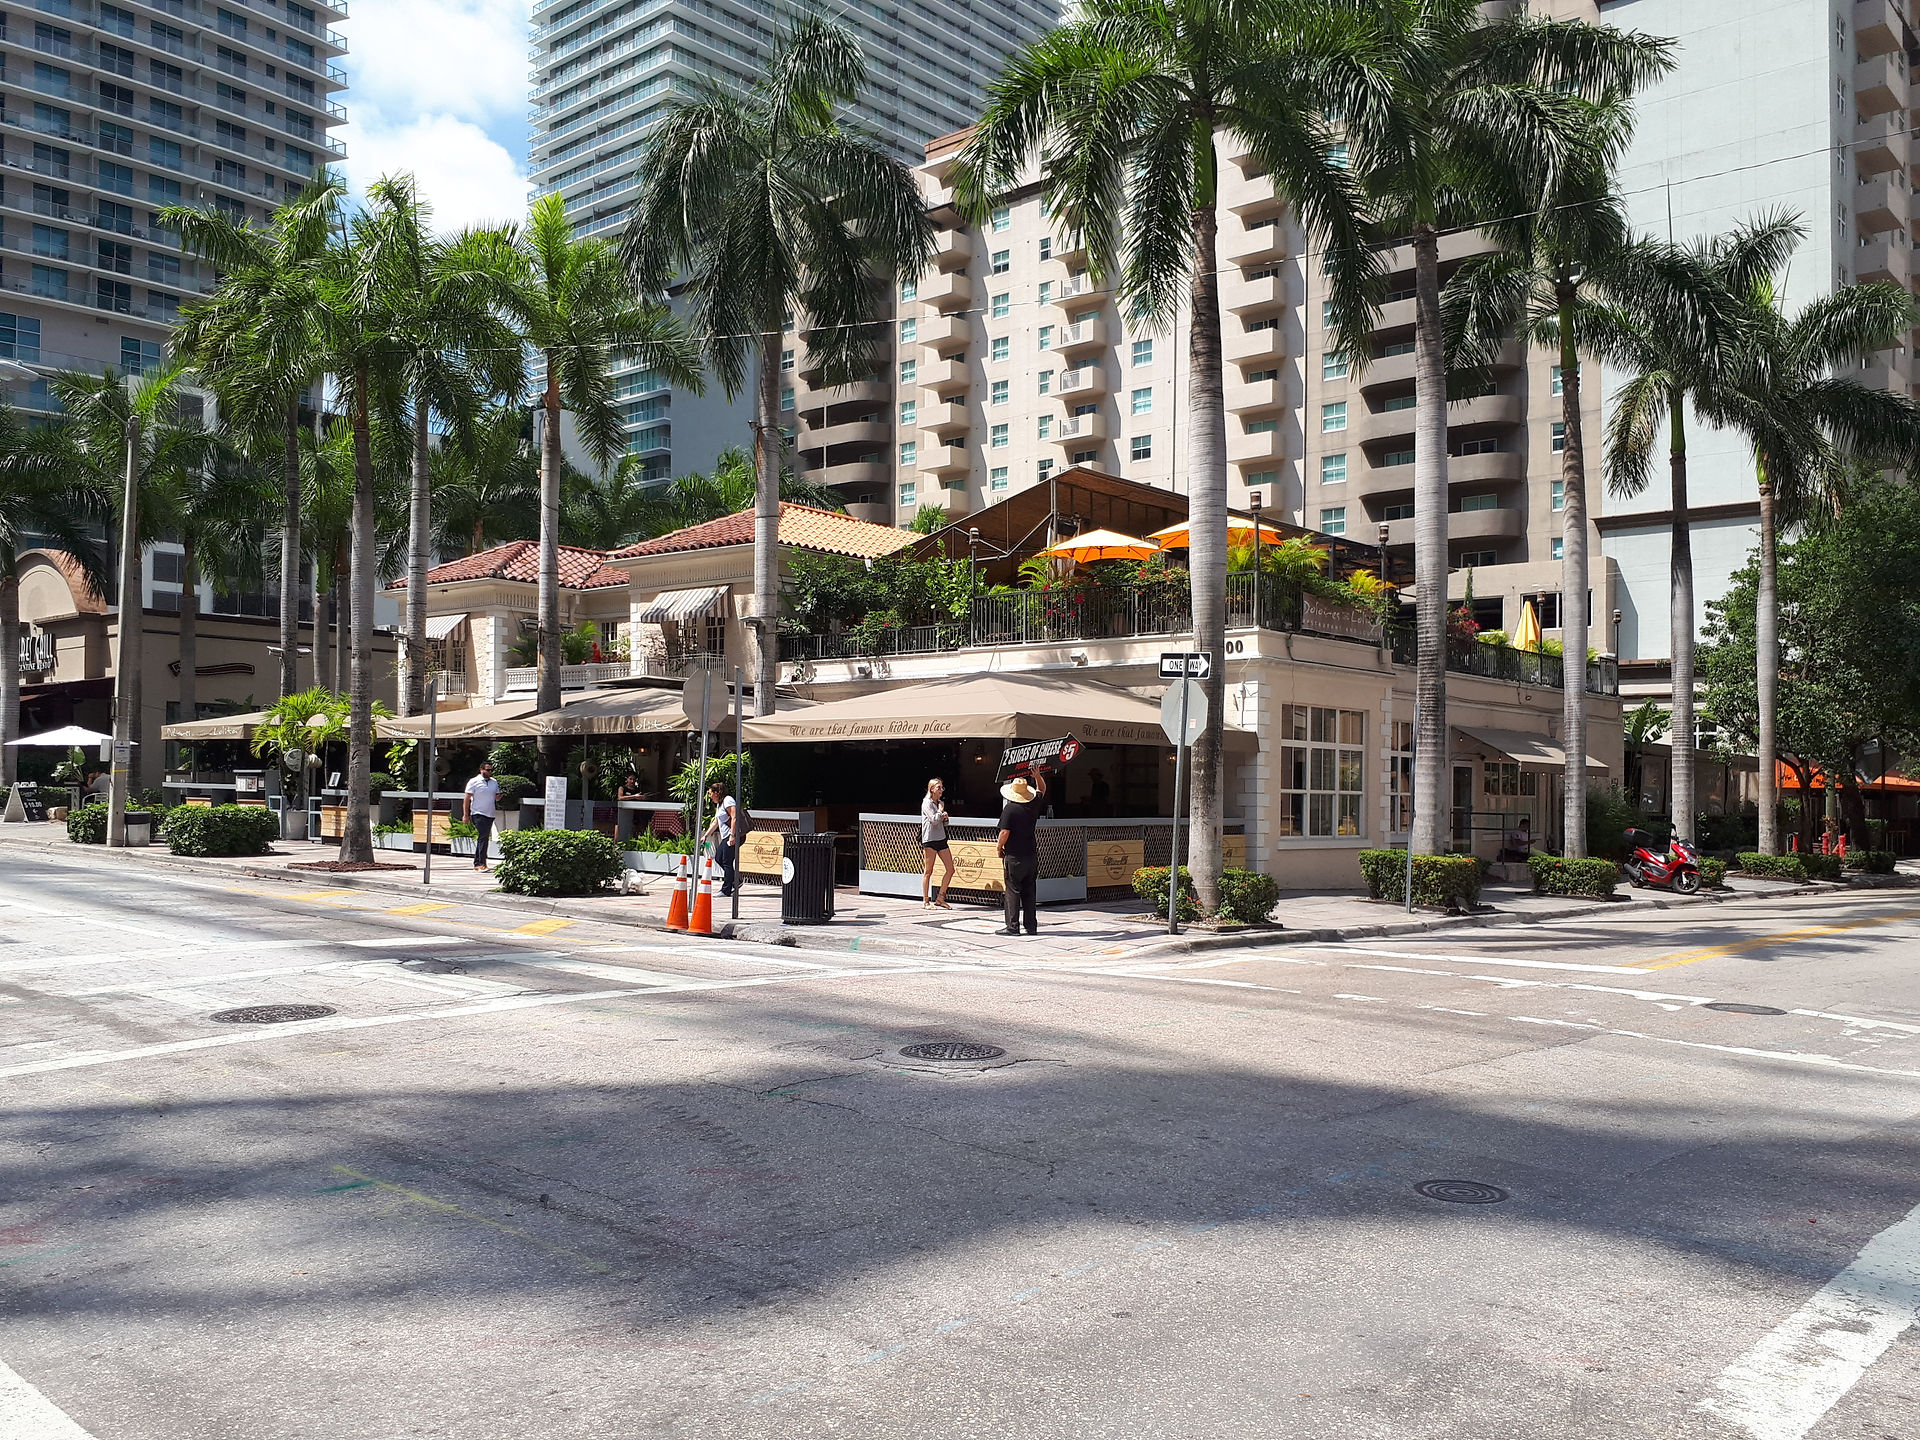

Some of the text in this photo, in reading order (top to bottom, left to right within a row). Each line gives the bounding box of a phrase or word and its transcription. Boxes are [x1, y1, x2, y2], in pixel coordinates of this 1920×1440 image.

[1169, 661, 1203, 670] ONE WAY
[626, 718, 673, 731] Lolita
[790, 719, 952, 736] We are that famous hidden place
[1082, 724, 1098, 737] We
[1101, 727, 1115, 736] are
[1117, 726, 1133, 738] that
[1002, 749, 1009, 766] 2
[1008, 746, 1031, 765] SLICES
[1029, 744, 1041, 760] OF
[1038, 740, 1063, 758] CHEESE
[1062, 743, 1077, 761] $5
